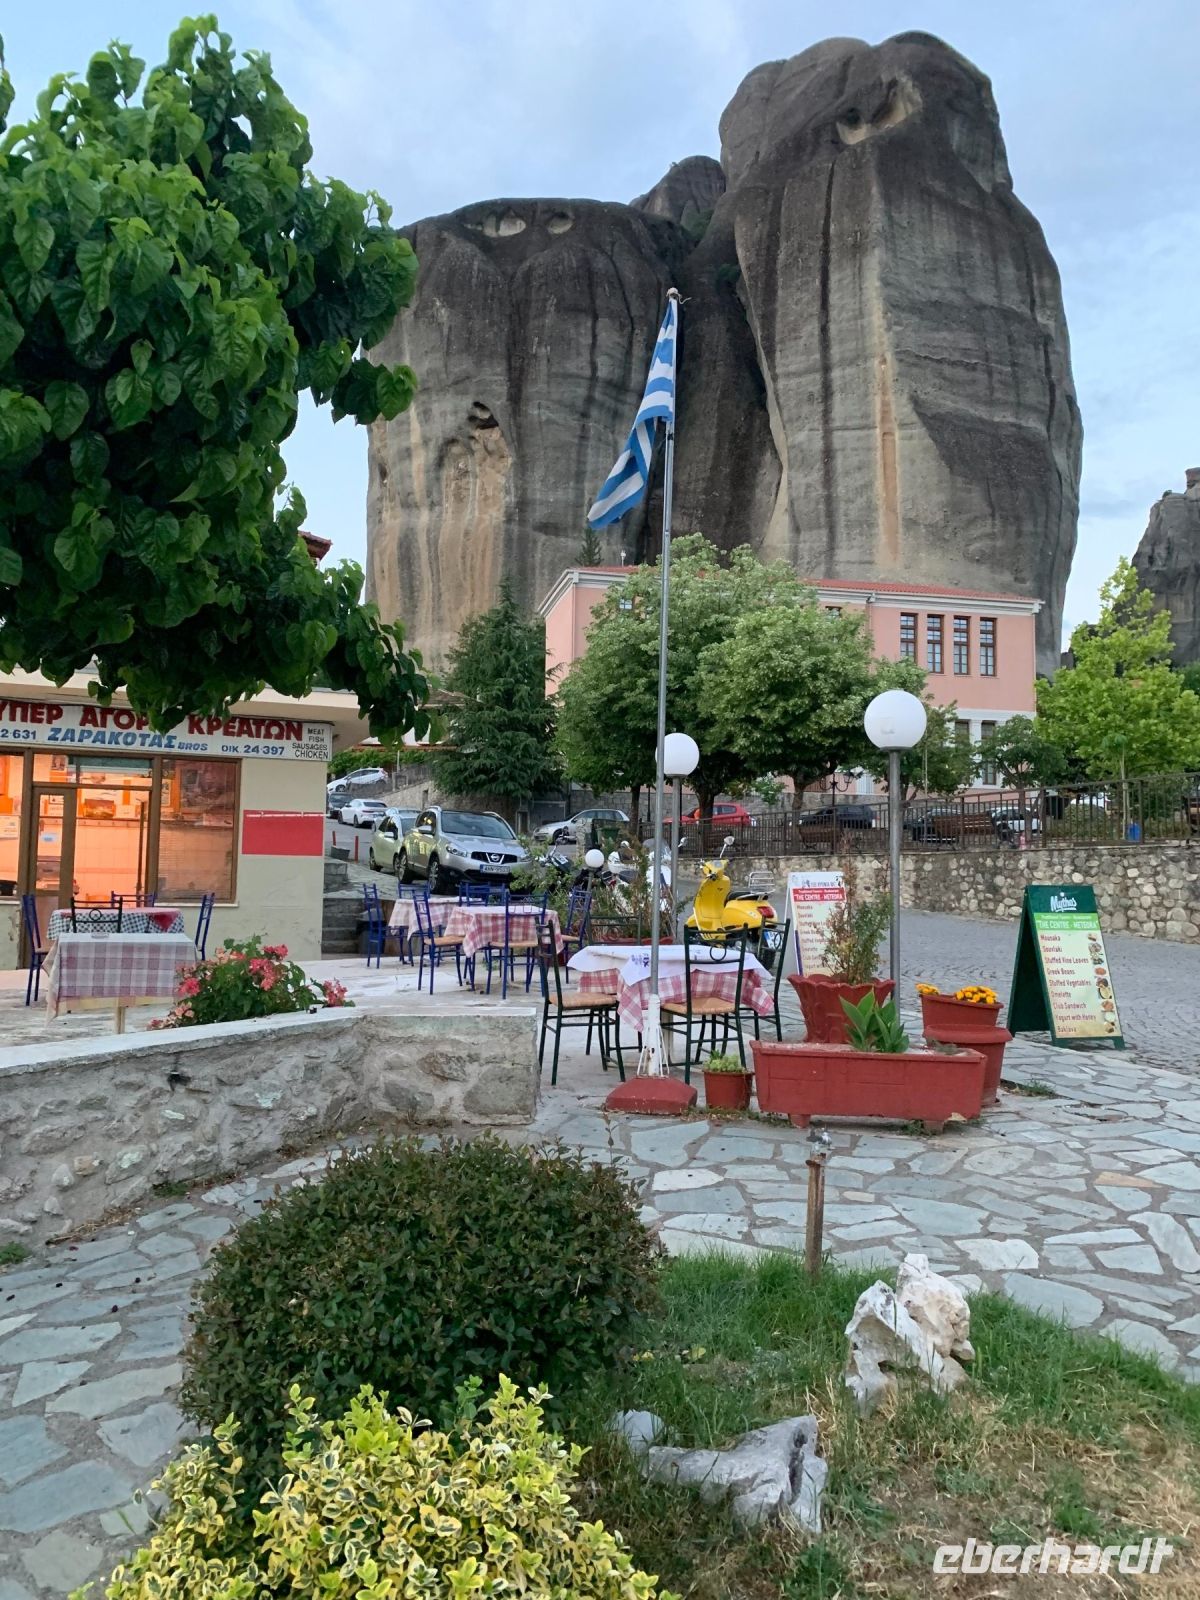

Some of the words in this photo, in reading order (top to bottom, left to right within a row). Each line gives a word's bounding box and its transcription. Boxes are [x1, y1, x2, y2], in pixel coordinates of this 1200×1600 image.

[79, 706, 150, 731] ΑΓΟΡ
[187, 714, 303, 741] ΚΡΕΑΤΩΝ
[307, 727, 325, 735] MEAT
[48, 727, 177, 749] ΖΑΡΑΚΟΤΑΣ
[178, 741, 208, 751] BROS
[292, 742, 328, 751] SAUSAGES
[294, 750, 329, 760] CHICKEN
[1050, 892, 1077, 912] Mythos
[1049, 920, 1070, 929] CENTRE
[1047, 967, 1060, 975] Greek
[1066, 979, 1091, 988] Vegetables
